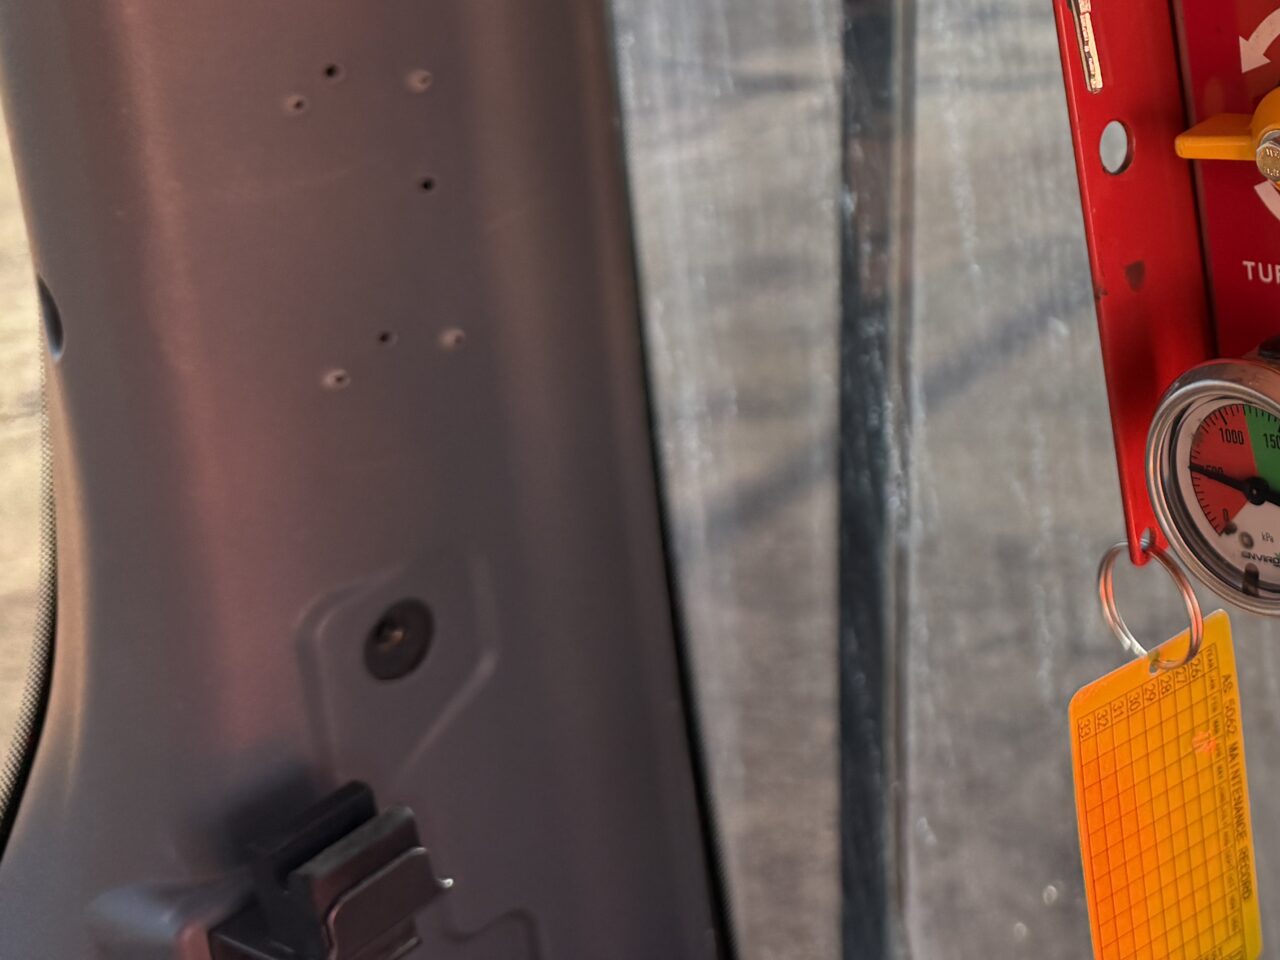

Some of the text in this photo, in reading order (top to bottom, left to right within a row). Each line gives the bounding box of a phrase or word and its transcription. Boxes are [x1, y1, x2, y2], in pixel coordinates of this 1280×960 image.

[1218, 427, 1245, 445] 1000
[1261, 532, 1274, 543] kPa
[1144, 682, 1157, 702] 29
[1161, 676, 1173, 696] 28
[1113, 700, 1124, 720] 31
[1128, 692, 1141, 712] 30
[1079, 718, 1092, 739] 33
[1097, 710, 1110, 731] 32
[1228, 741, 1247, 841] MAINTENANCE
[1238, 845, 1252, 902] RECORD
